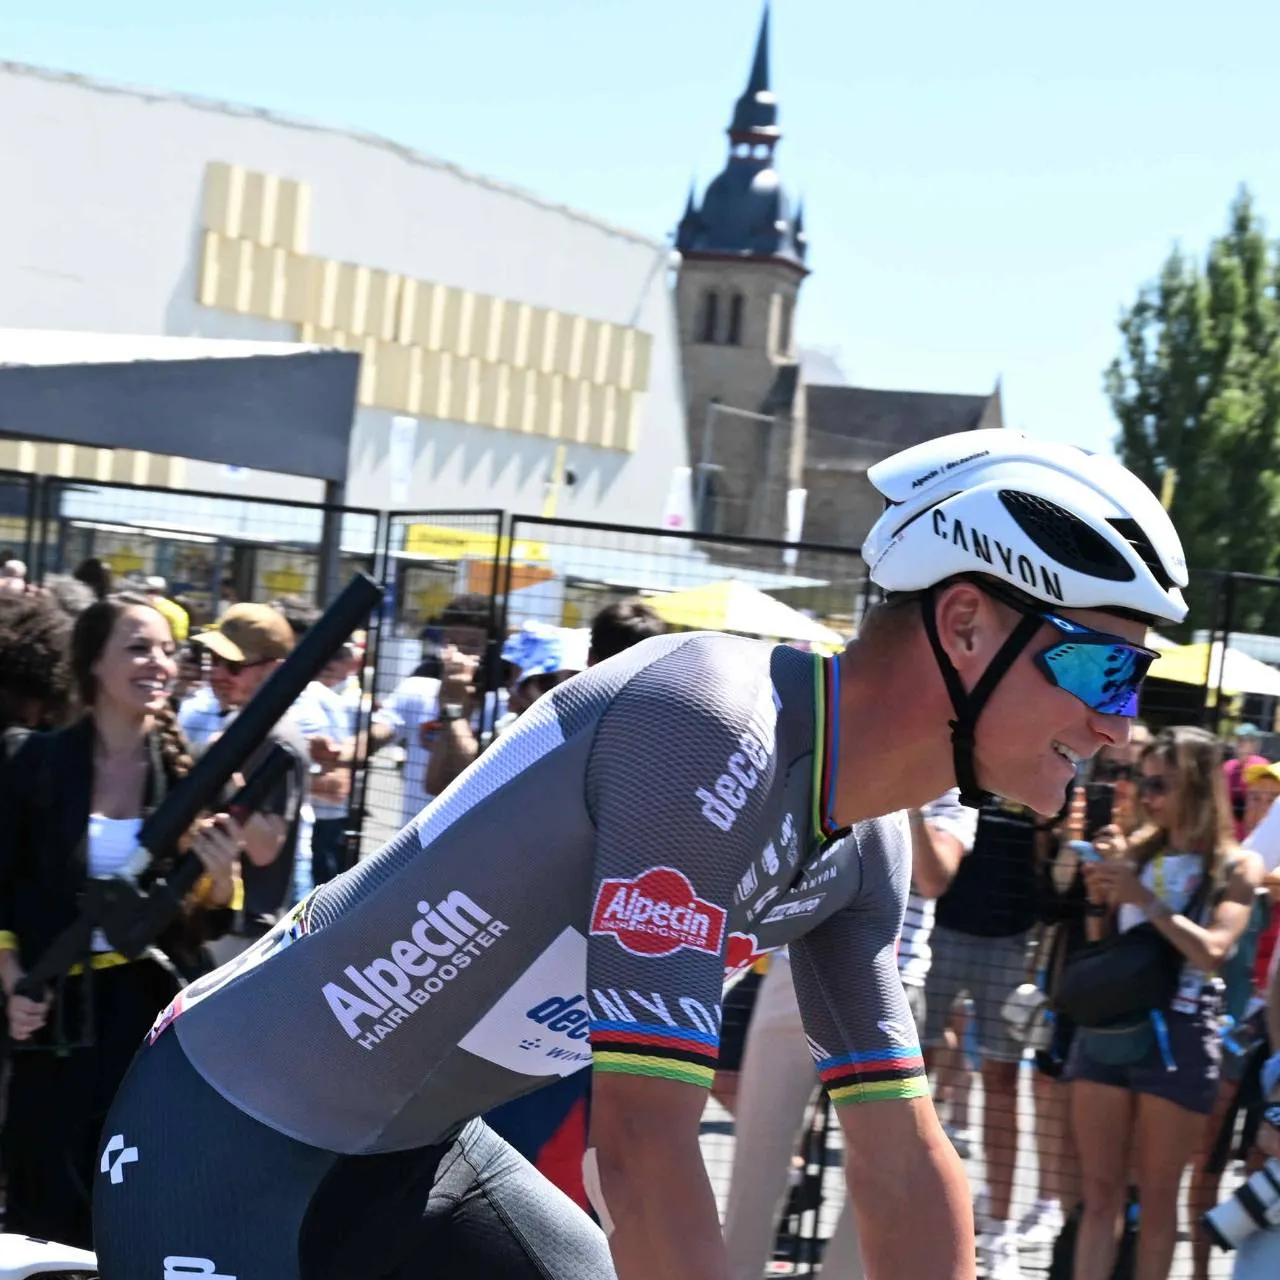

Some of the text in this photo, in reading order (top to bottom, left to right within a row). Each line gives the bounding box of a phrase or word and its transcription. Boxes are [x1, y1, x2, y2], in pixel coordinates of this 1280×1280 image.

[932, 508, 1064, 602] CANYON
[603, 886, 711, 938] Alpecin
[321, 889, 493, 1041] Alpecin
[357, 918, 511, 1051] HAIR BOOSTER
[526, 994, 592, 1044] dec
[587, 988, 723, 1038] NYO
[546, 1046, 594, 1061] WIN
